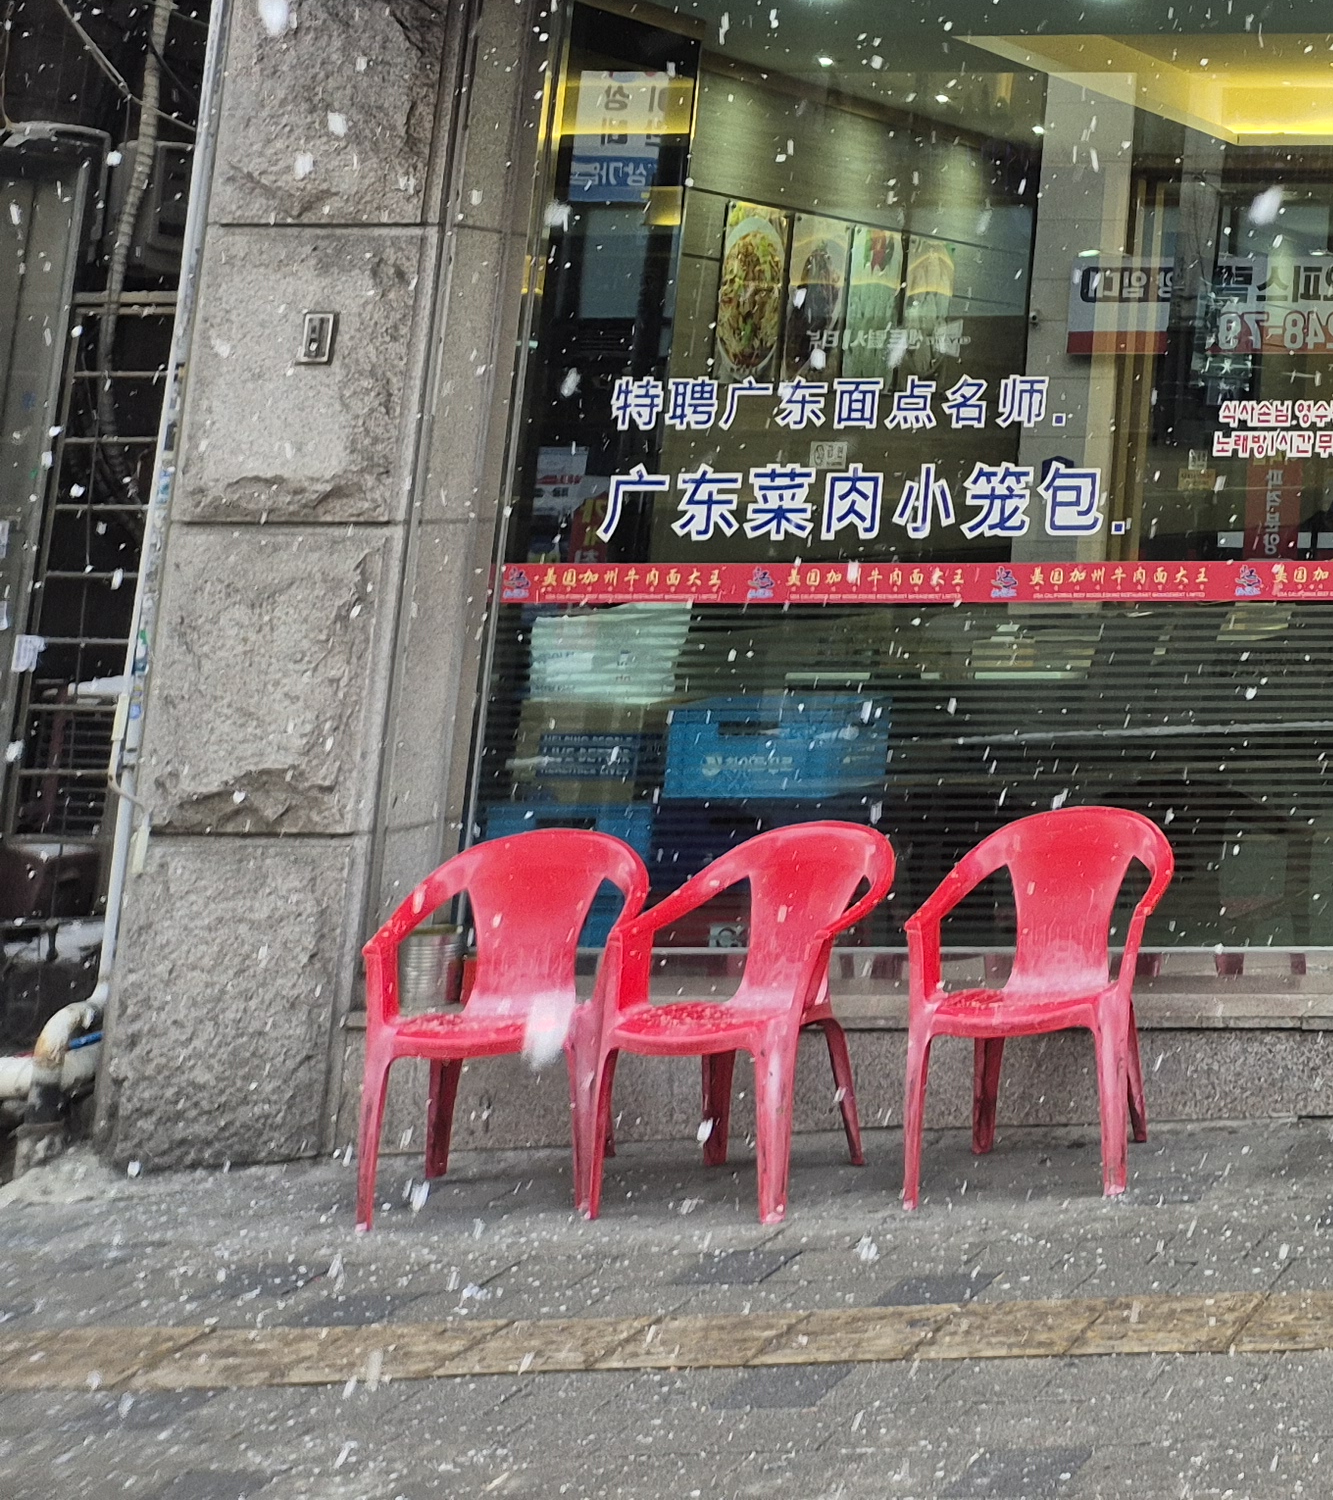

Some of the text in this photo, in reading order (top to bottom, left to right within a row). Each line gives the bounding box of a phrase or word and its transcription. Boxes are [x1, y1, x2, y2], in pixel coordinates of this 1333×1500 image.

[1219, 400, 1292, 428] 식사손님
[1028, 565, 1209, 586] 美国加州牛肉面大王
